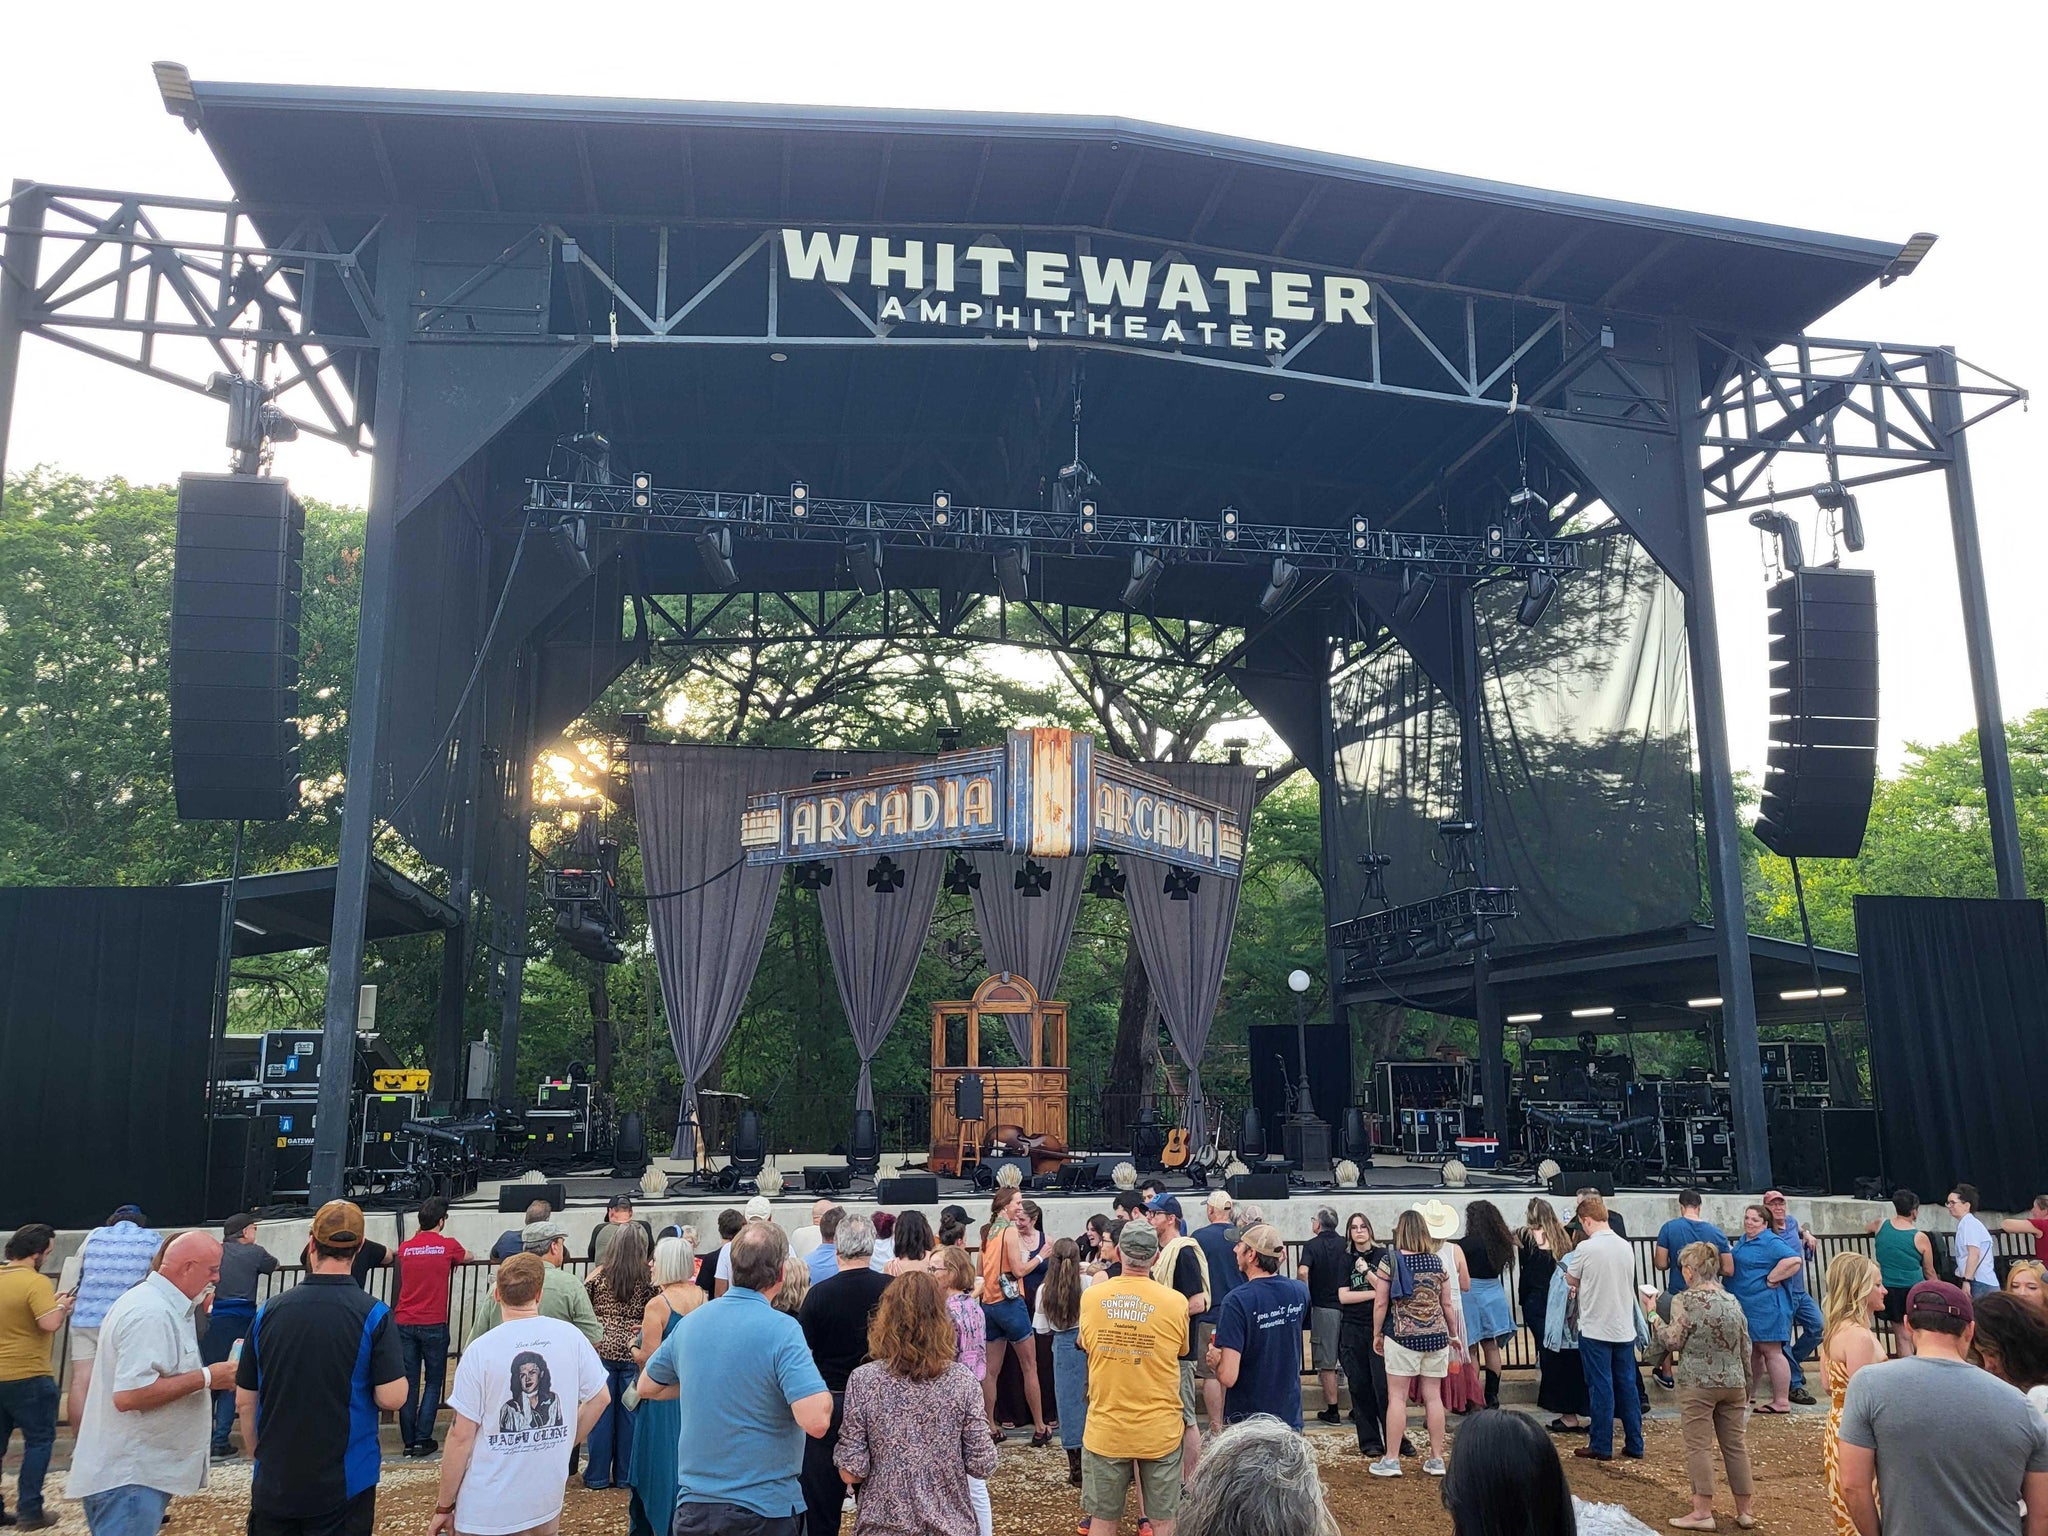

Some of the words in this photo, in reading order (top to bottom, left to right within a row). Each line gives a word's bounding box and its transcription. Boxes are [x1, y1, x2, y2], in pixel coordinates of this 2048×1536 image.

[782, 229, 1375, 326] WHITEWATER
[880, 296, 1287, 351] AMPHITHEATER
[792, 778, 994, 846] ARCADIA
[1095, 782, 1214, 858] ARCADIA
[1101, 1299, 1156, 1314] SONGWRITER
[1107, 1308, 1148, 1323] SHINDIG
[488, 1431, 530, 1446] PATSY
[533, 1426, 568, 1442] CLINE
